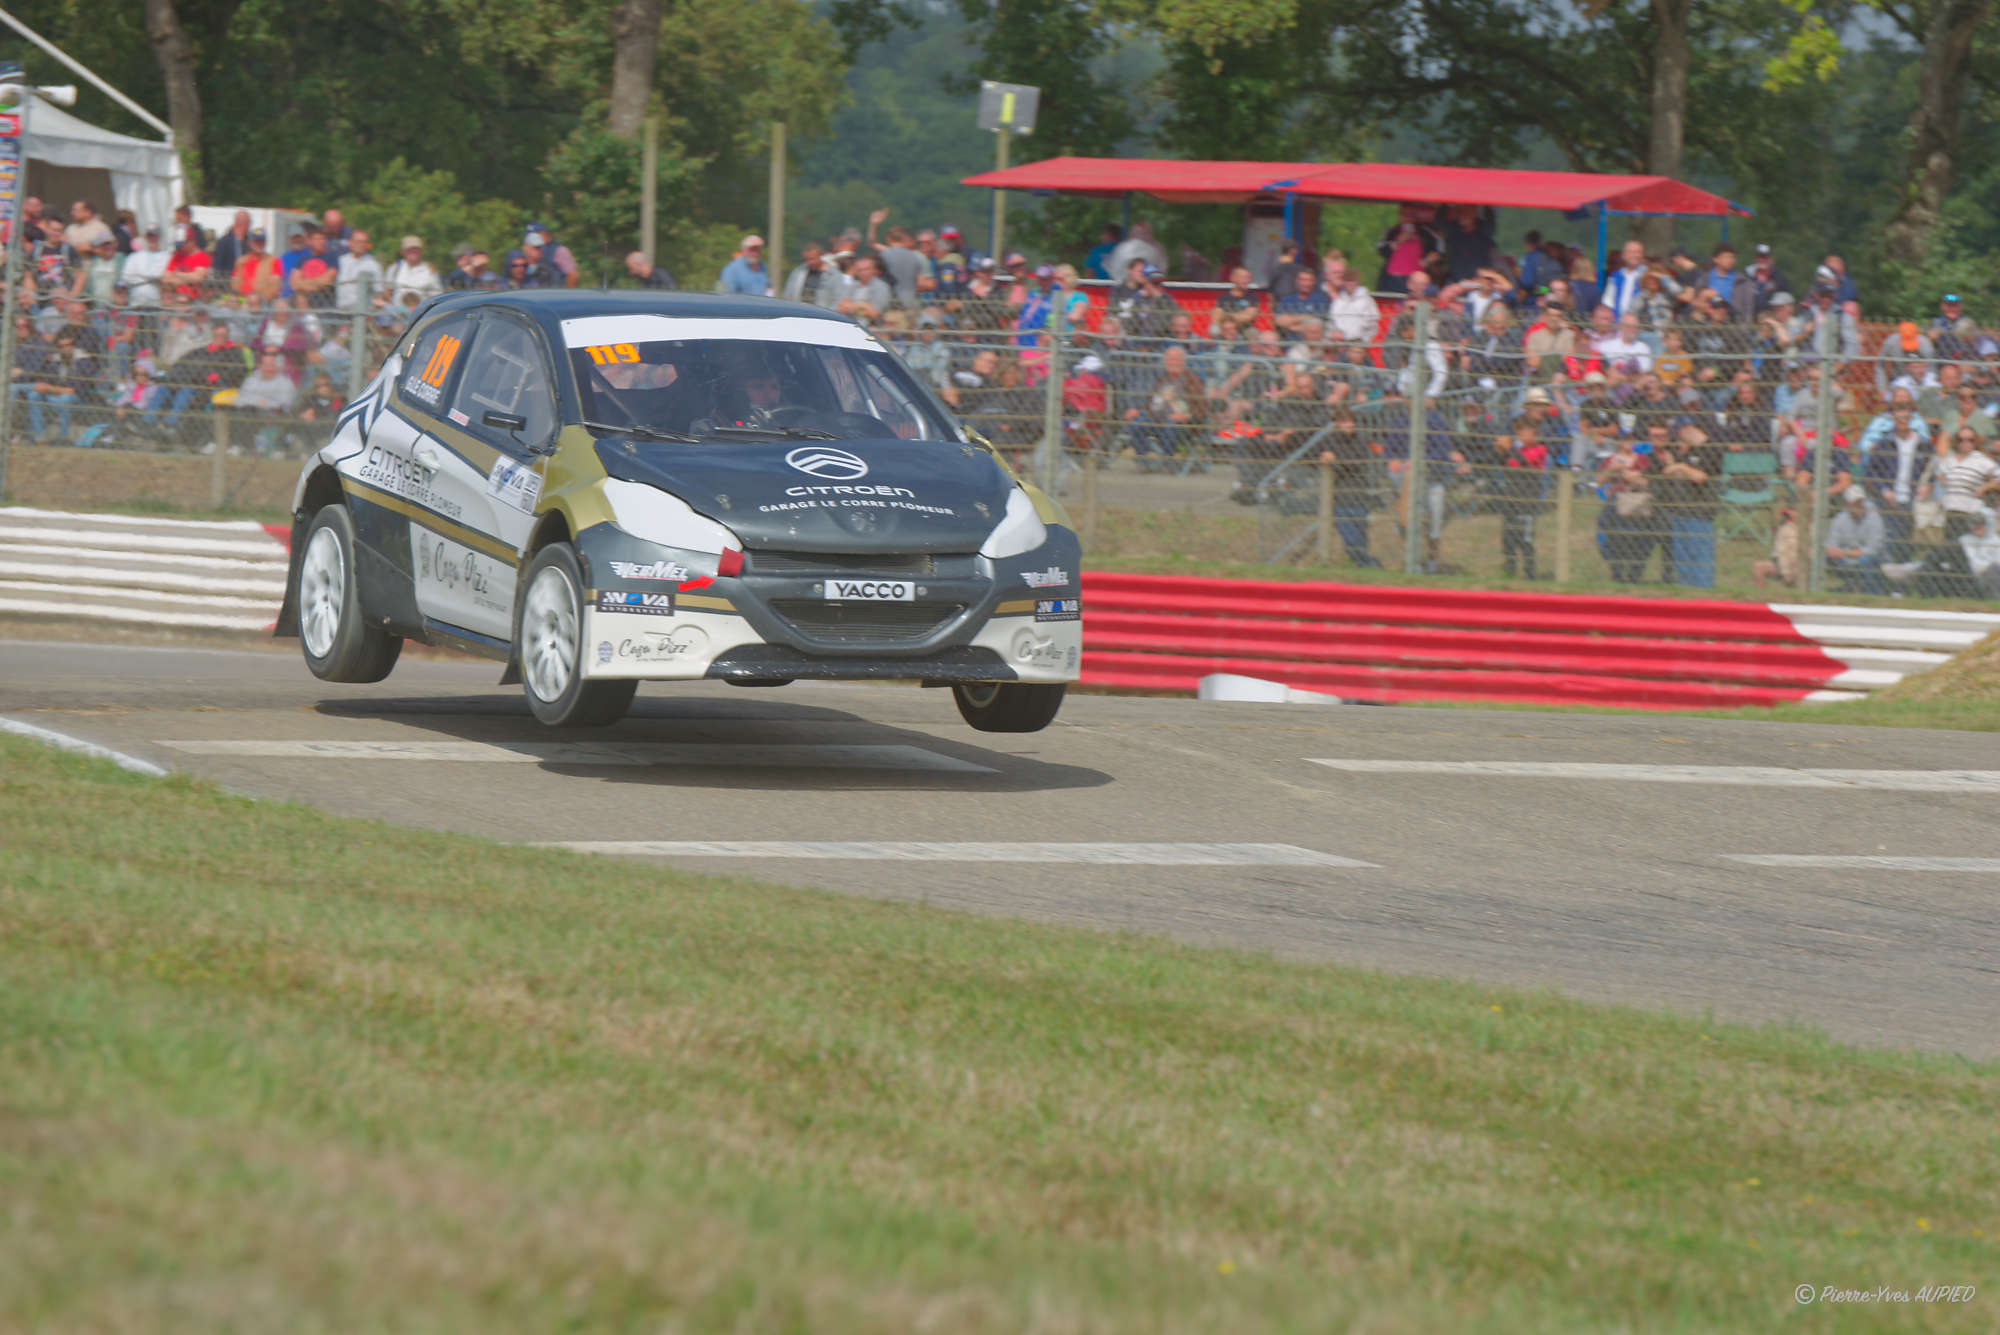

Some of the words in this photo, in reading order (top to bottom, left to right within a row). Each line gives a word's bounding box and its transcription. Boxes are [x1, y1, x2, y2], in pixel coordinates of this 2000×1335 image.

[421, 334, 461, 387] 119
[584, 343, 641, 365] 119
[360, 465, 396, 489] GARAGE
[785, 485, 916, 498] CITROËN
[759, 501, 817, 512] GARAGE
[840, 500, 888, 509] CORRE
[890, 501, 956, 516] PLOMEUR
[834, 582, 906, 599] YACCO
